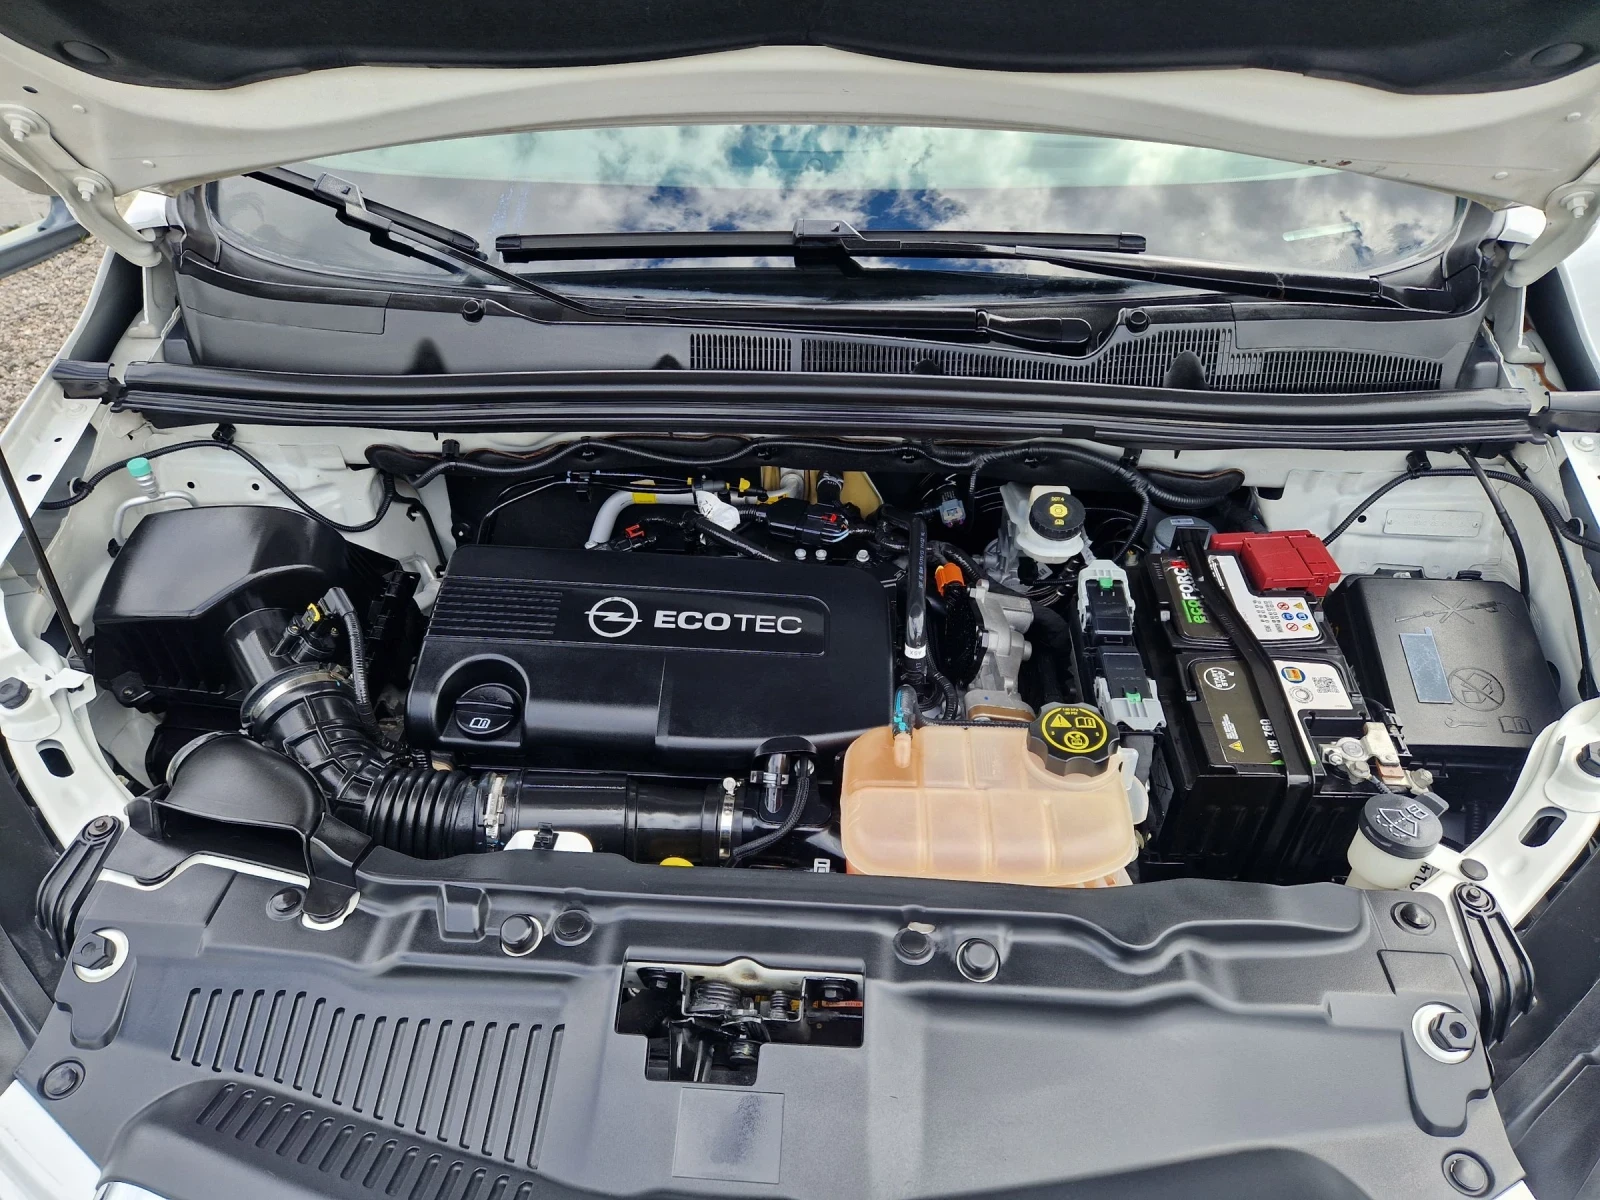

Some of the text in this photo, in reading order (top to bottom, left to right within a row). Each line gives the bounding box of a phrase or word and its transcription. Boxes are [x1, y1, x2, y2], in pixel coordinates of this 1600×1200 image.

[1171, 560, 1206, 624] ecoFORC
[654, 610, 802, 634] ECOTEC
[1210, 668, 1222, 688] START
[1217, 671, 1228, 687] STOP
